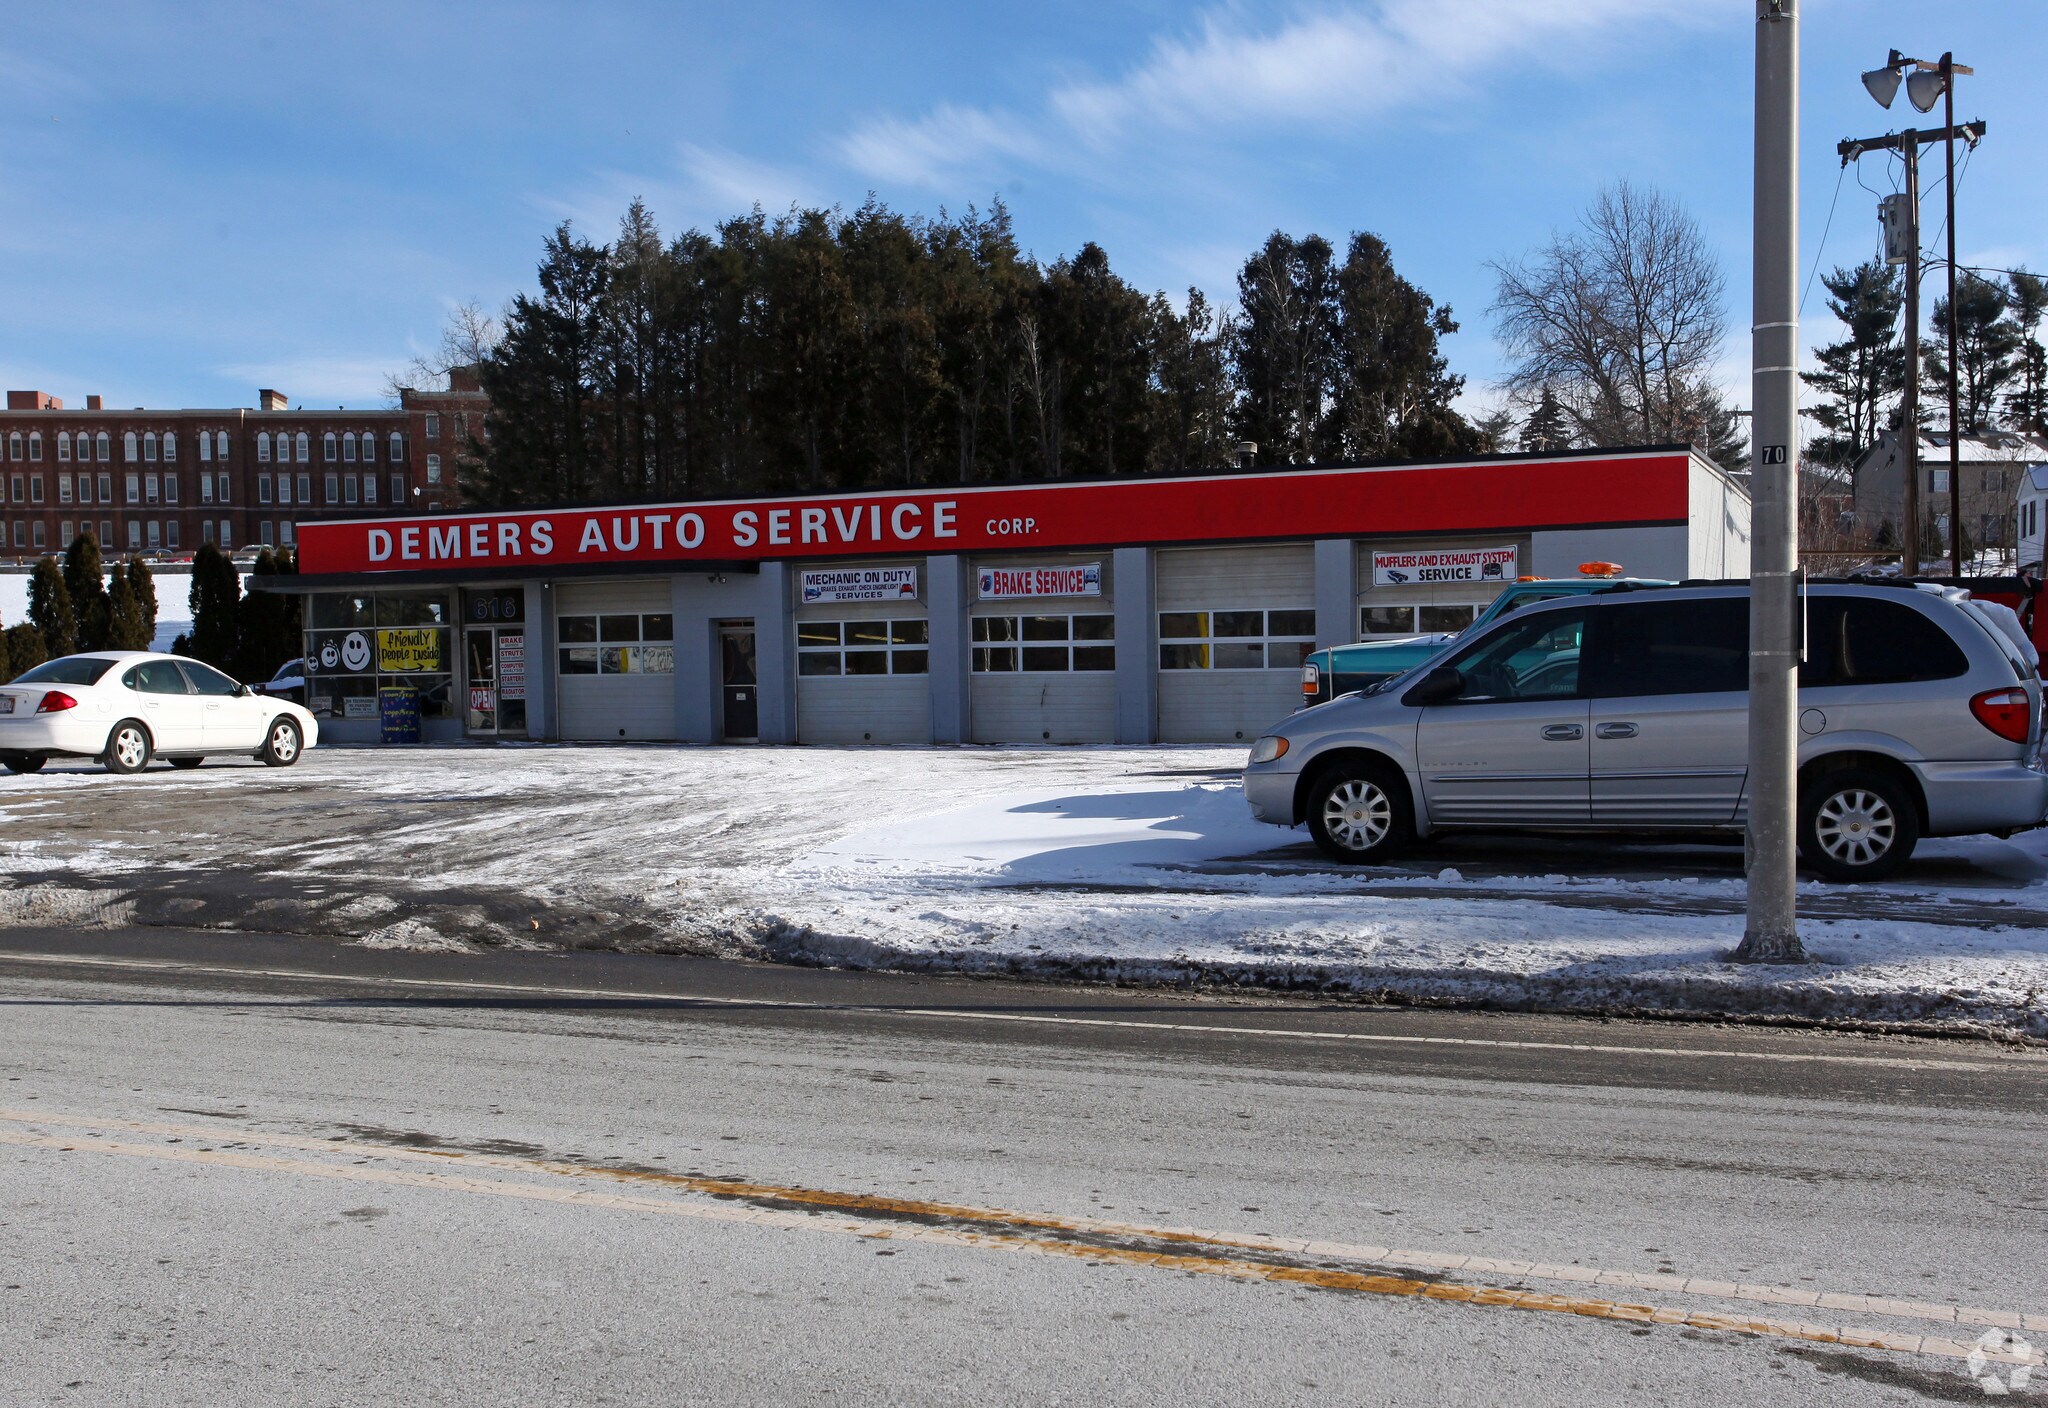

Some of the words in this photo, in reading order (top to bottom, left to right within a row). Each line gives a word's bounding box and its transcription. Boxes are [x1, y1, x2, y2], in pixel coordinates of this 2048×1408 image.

[1763, 446, 1784, 464] 70
[367, 520, 554, 562] DEMERS
[578, 512, 706, 553] AUTO
[732, 501, 958, 548] SERVICE
[986, 517, 1040, 535] CORP.
[1376, 555, 1417, 568] MUFFLERS
[1417, 555, 1438, 567] AND
[1439, 553, 1481, 566] EXHAUST
[1482, 551, 1514, 564] SYSTEM
[806, 572, 861, 585] MECHANIC
[864, 572, 880, 583] ON
[883, 570, 912, 582] DUTY
[993, 571, 1032, 594] BRAKE
[1036, 569, 1083, 594] SERVICE
[1418, 567, 1472, 581] SERVICE
[835, 591, 883, 600] SERVICES
[473, 597, 516, 619] 616
[471, 690, 495, 708] OPEN
